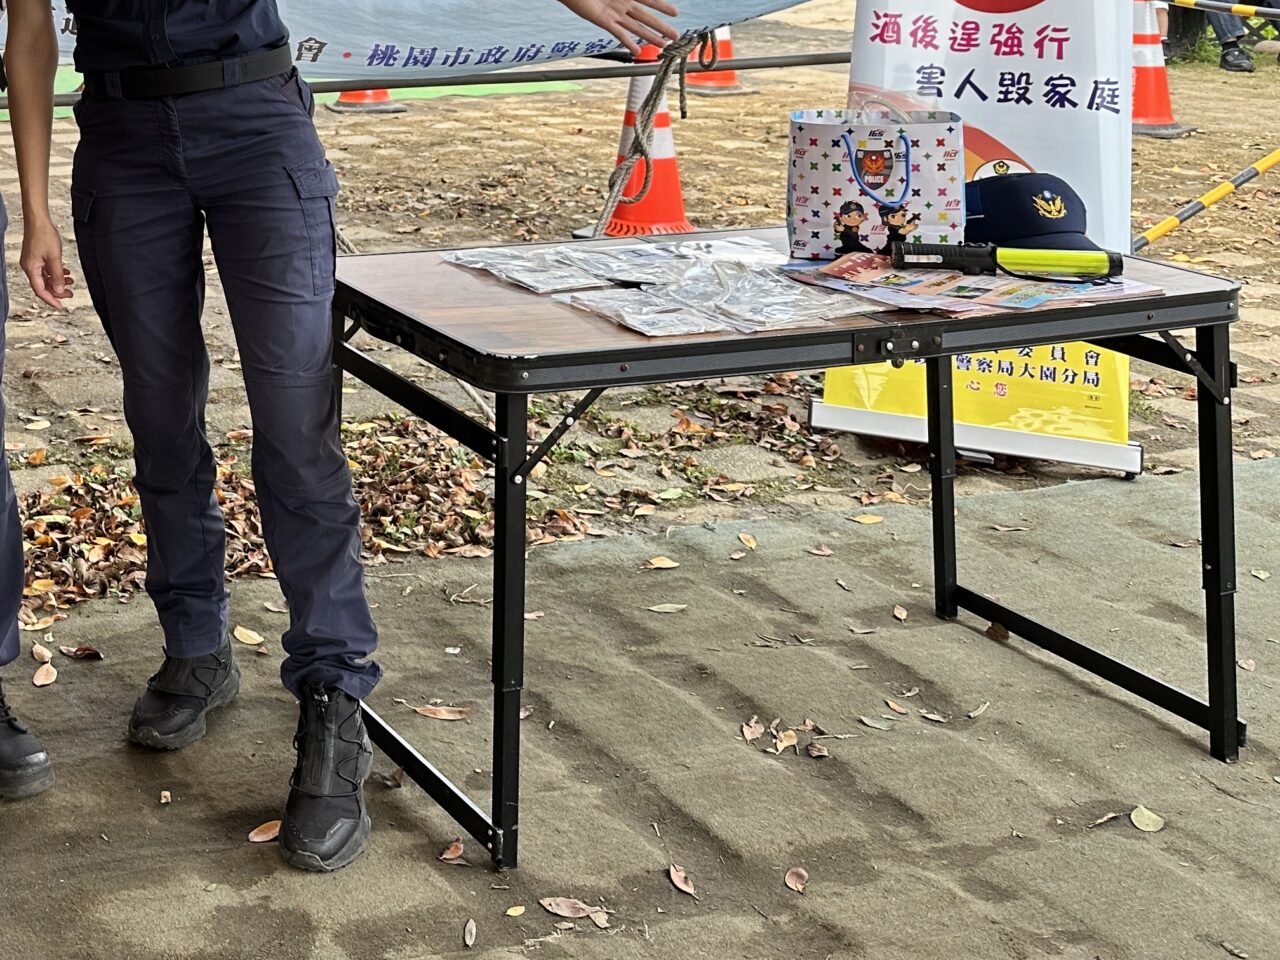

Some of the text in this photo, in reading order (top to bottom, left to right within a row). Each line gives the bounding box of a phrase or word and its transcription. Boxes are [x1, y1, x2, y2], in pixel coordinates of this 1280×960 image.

[869, 10, 1071, 60] 酒後逞強行
[915, 63, 1121, 114] 害人毀家庭
[956, 354, 1101, 387] 警察局大園分局
